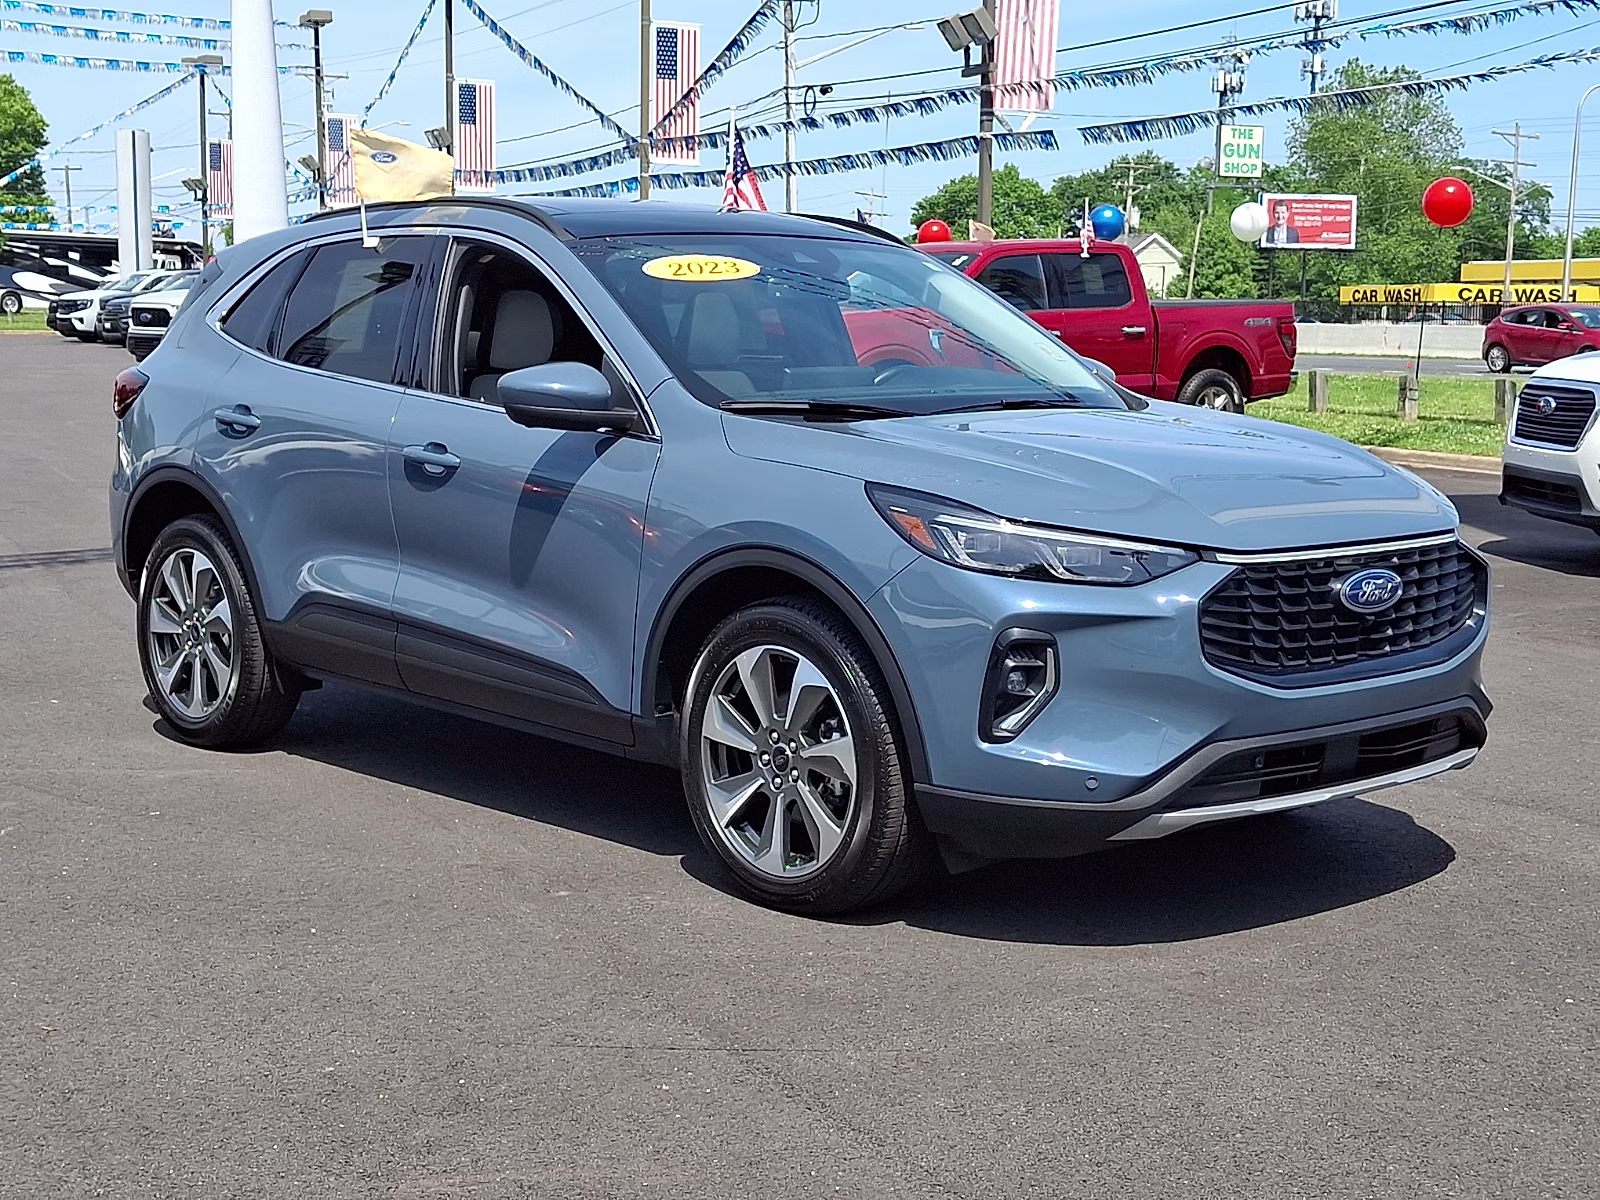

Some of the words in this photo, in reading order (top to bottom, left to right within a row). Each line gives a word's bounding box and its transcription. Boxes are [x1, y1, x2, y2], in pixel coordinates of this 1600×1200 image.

[1231, 128, 1254, 139] THE
[1223, 143, 1260, 159] GUN
[1224, 162, 1258, 174] SHOP
[668, 261, 740, 276] 2023
[1352, 289, 1378, 302] CAR
[1384, 288, 1421, 302] WASH
[1458, 288, 1503, 302] CAR
[1514, 288, 1577, 303] WASH
